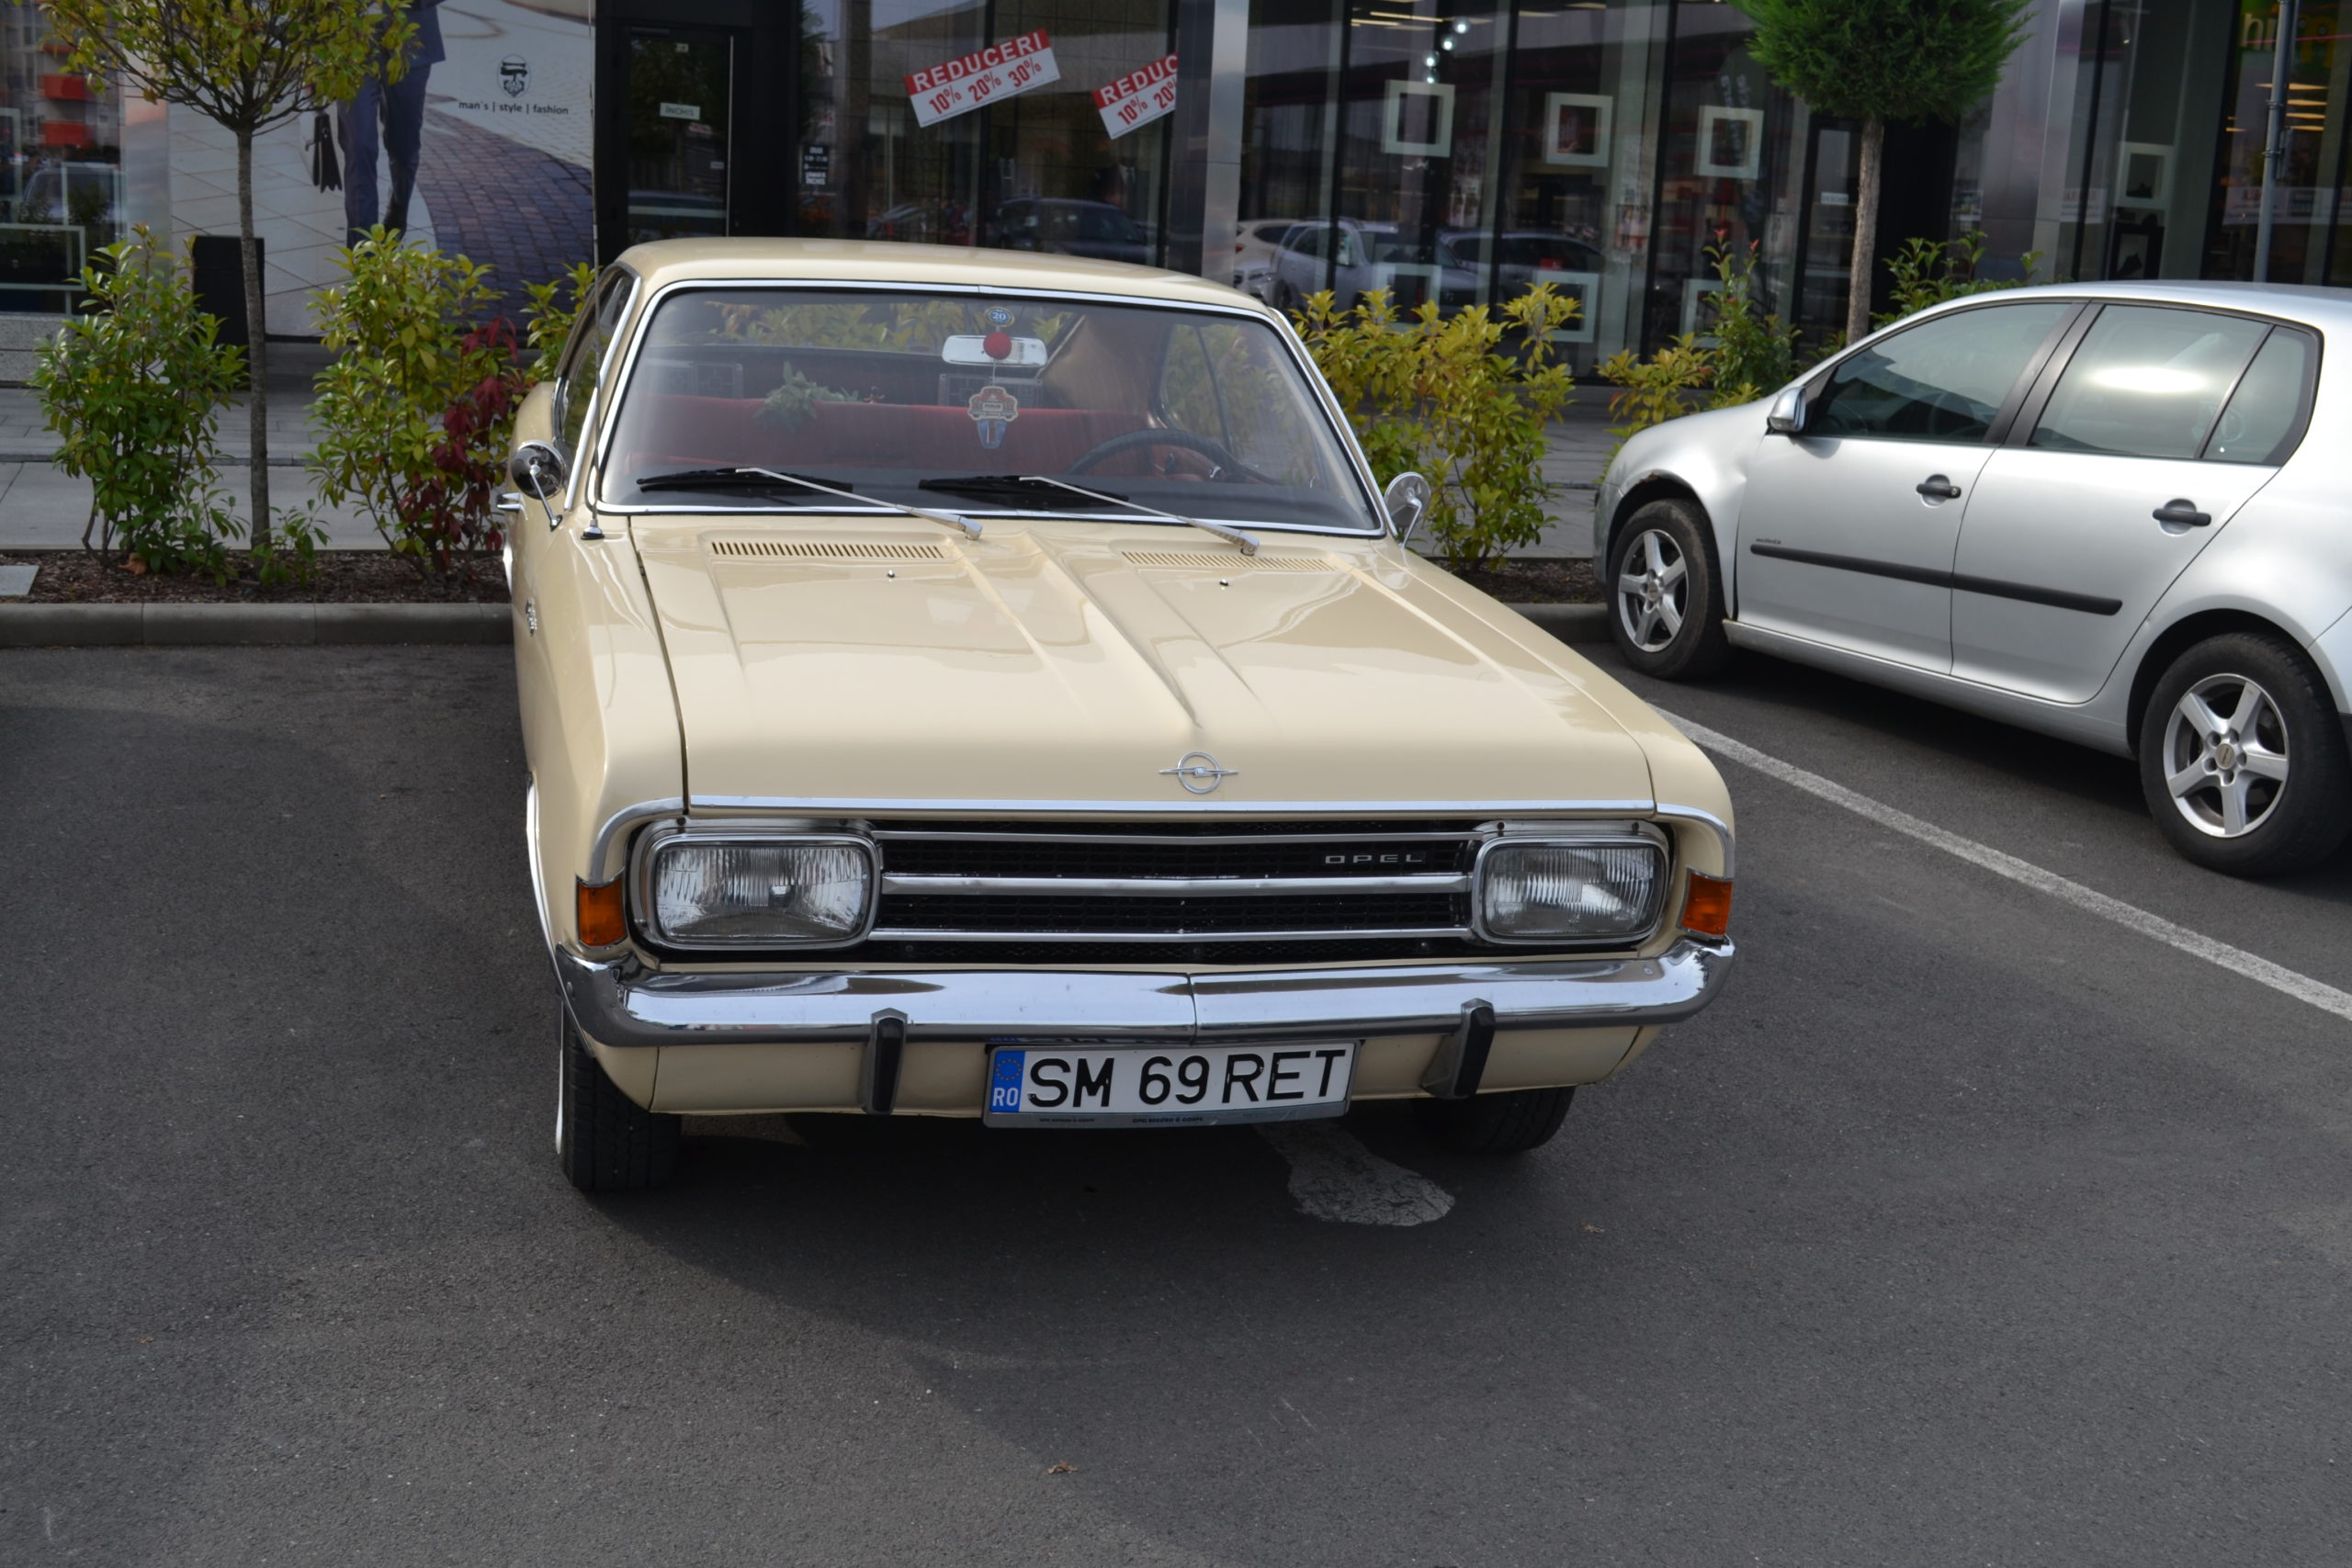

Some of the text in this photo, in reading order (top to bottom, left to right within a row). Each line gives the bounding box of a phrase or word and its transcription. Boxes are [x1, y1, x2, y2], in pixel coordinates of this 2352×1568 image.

[912, 32, 1042, 92] REDUCERI
[929, 57, 1042, 114] 10% 20% 30%
[499, 104, 522, 113] style
[533, 104, 569, 115] fashion
[1117, 95, 1148, 125] 10%
[1325, 854, 1422, 864] OPEL
[1027, 1049, 1347, 1108] SM 69 RET
[992, 1087, 1020, 1107] RO
